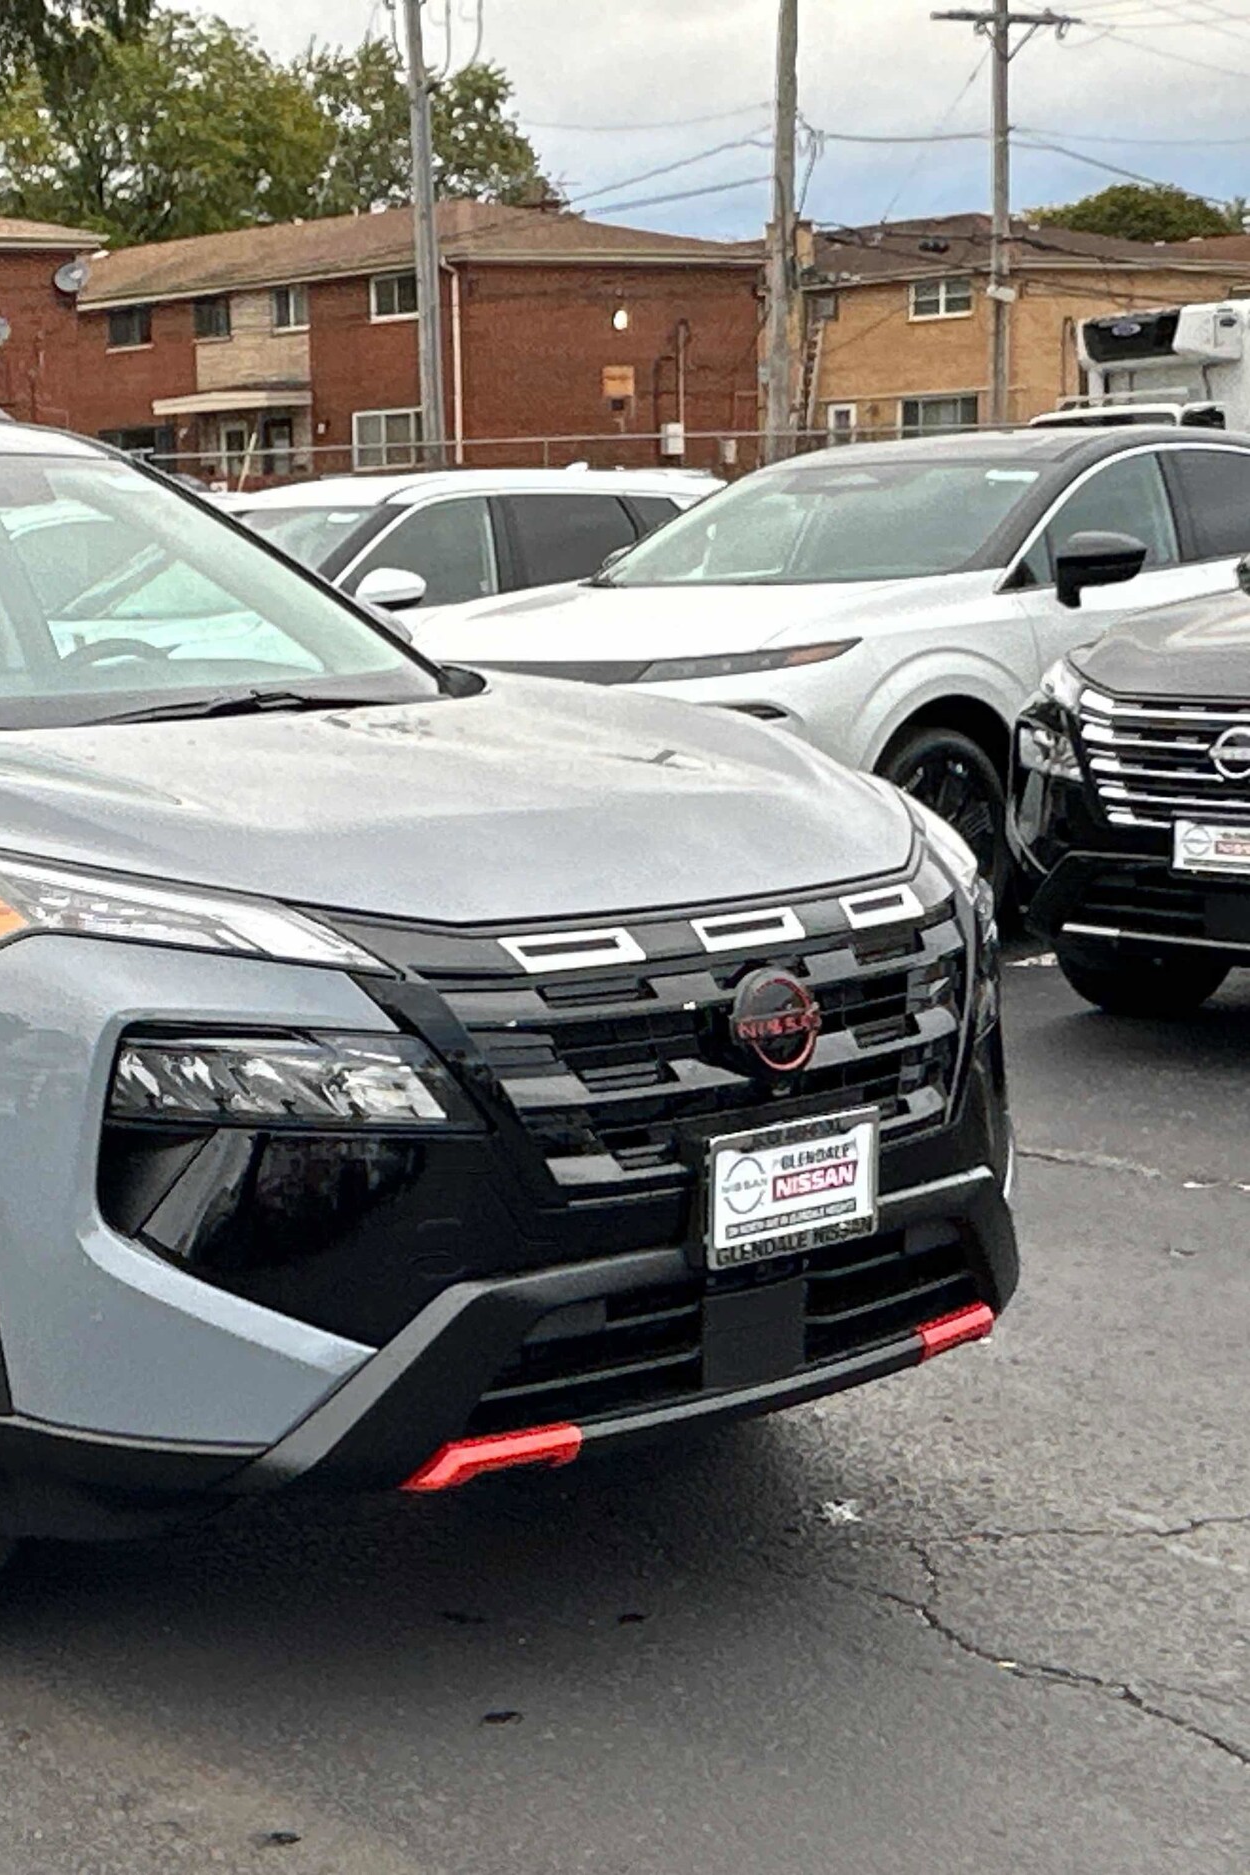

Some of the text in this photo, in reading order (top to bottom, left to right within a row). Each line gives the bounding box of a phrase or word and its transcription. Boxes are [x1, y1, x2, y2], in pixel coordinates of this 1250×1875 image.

[780, 1143, 850, 1170] GLENDALE
[775, 1162, 854, 1197] NISSAN
[716, 1232, 807, 1266] GLENDALE
[813, 1216, 873, 1246] NISSAN
